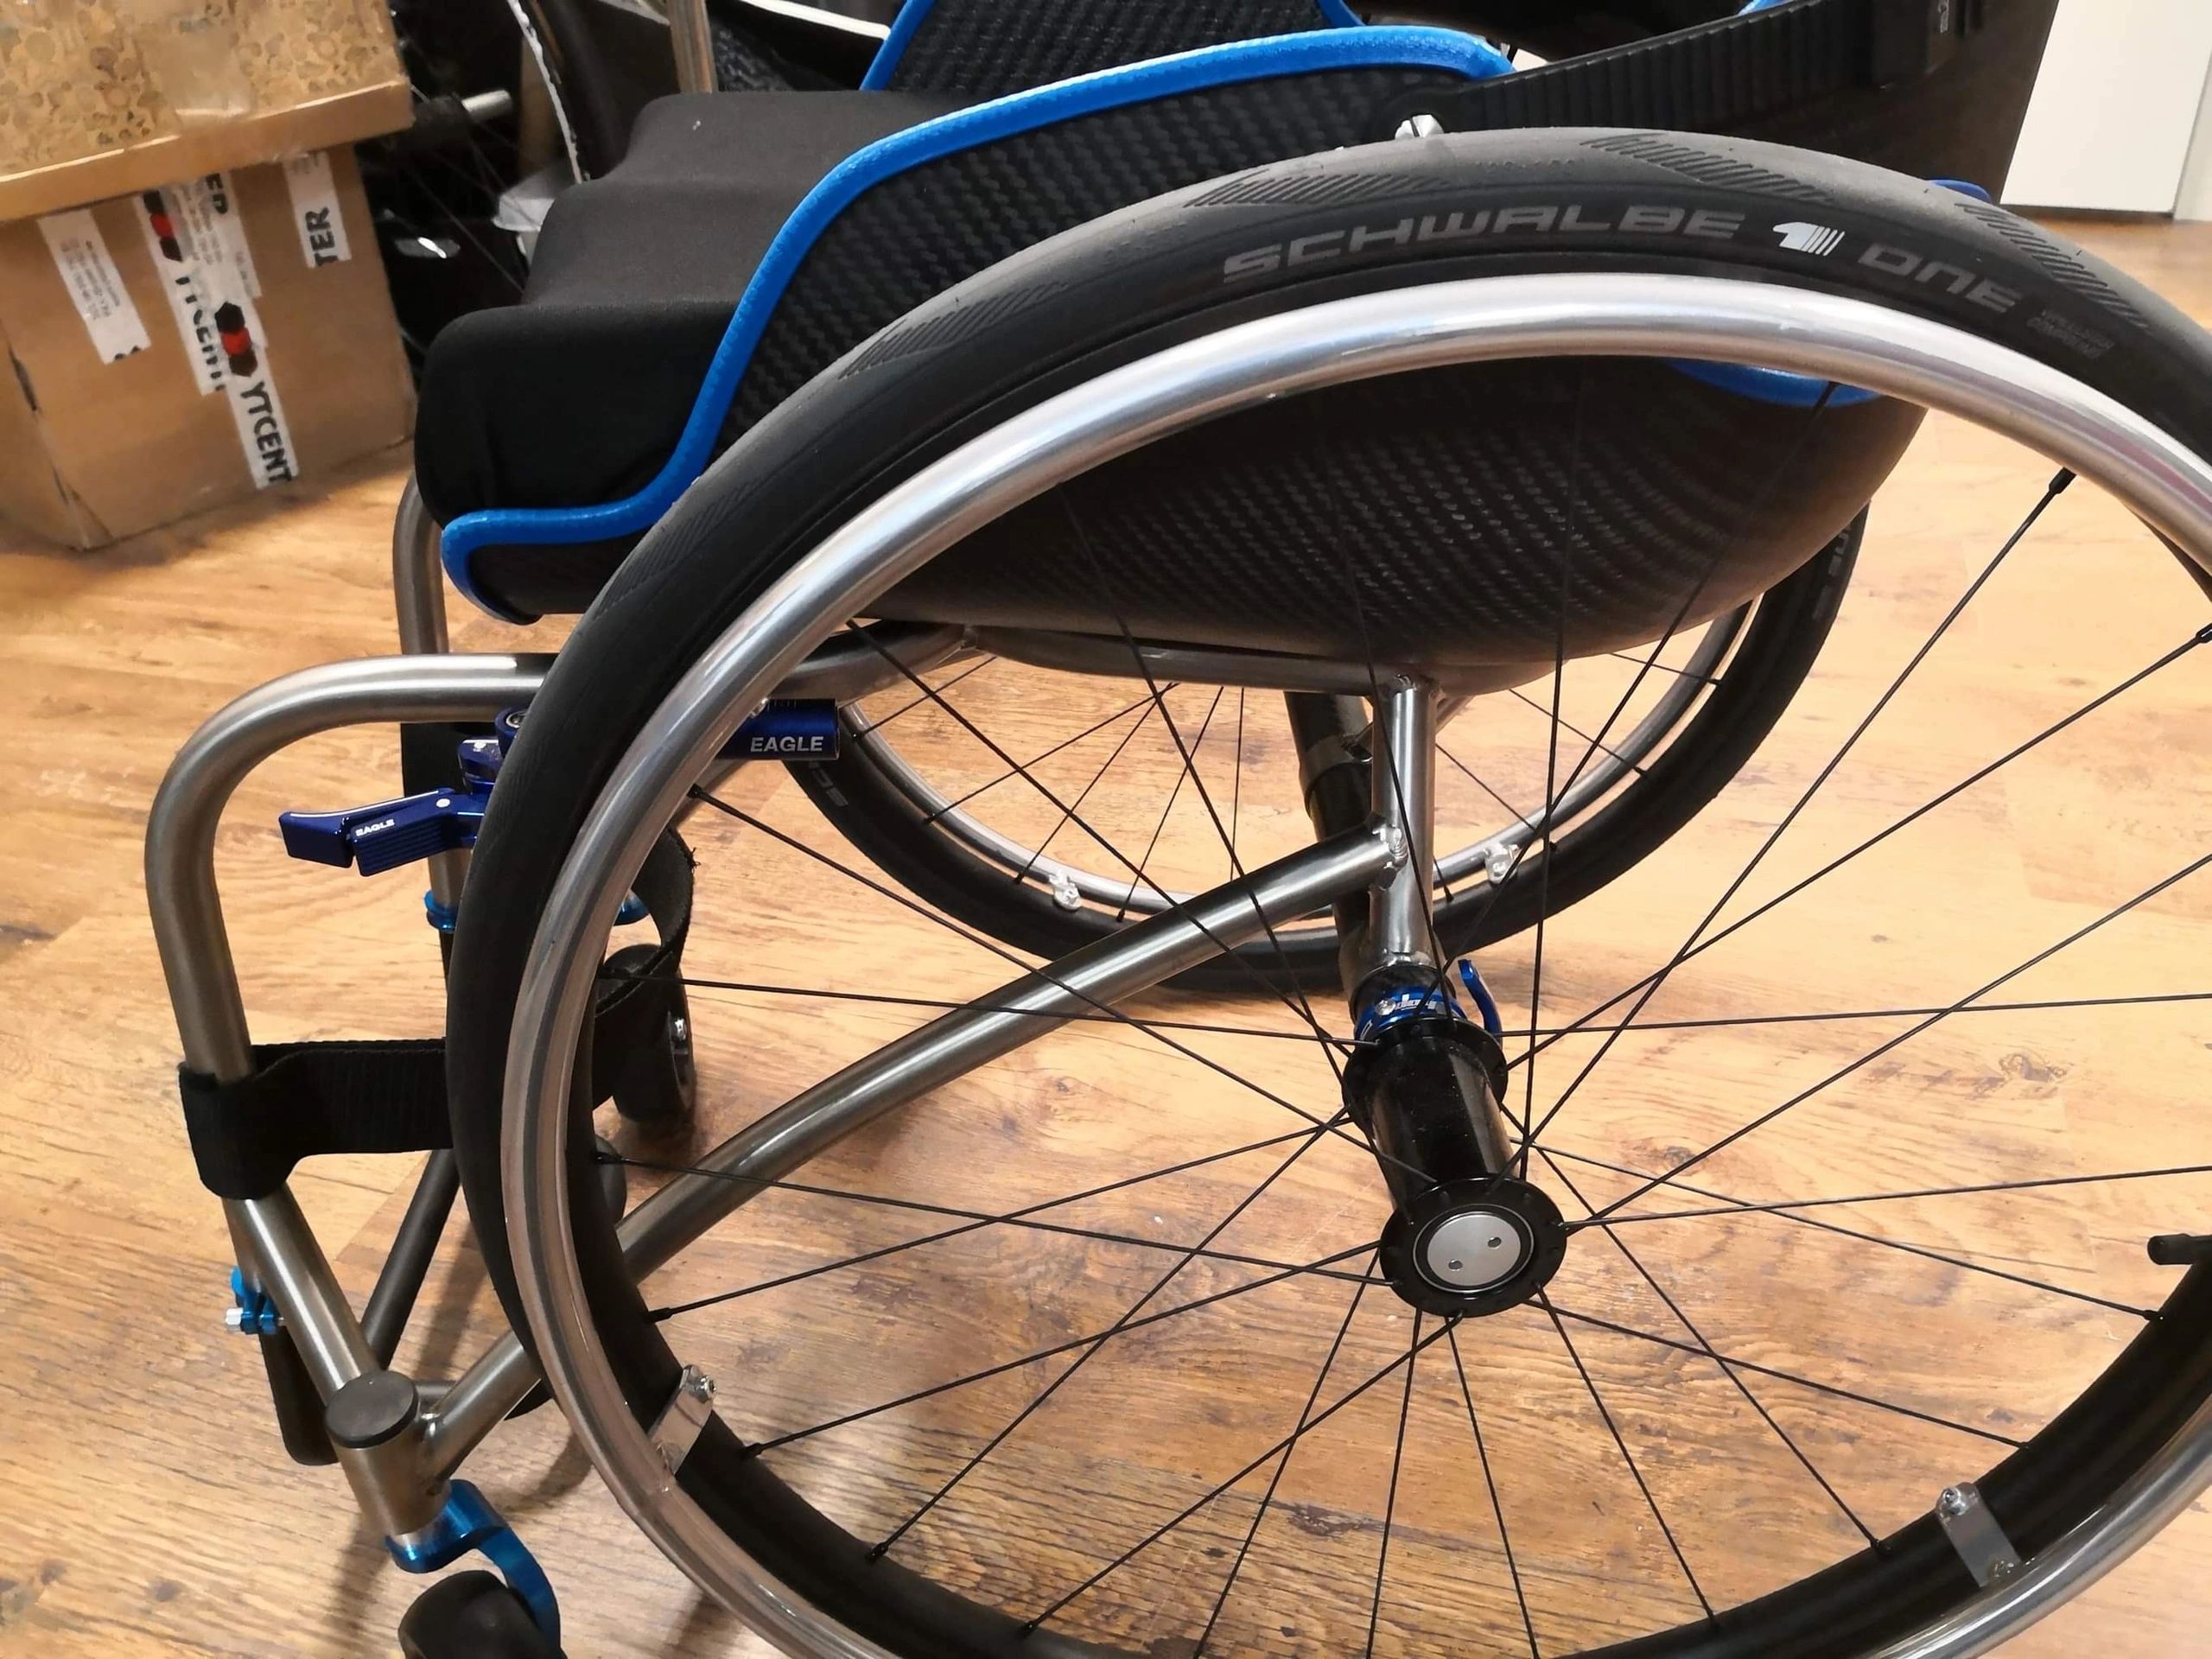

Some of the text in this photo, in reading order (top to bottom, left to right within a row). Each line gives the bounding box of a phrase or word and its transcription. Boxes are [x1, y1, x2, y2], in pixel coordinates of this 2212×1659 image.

[1224, 204, 1746, 284] SCHWALBE
[1857, 242, 2027, 315] ONE
[750, 735, 824, 753] EAGLE
[355, 818, 396, 836] EAGLE
